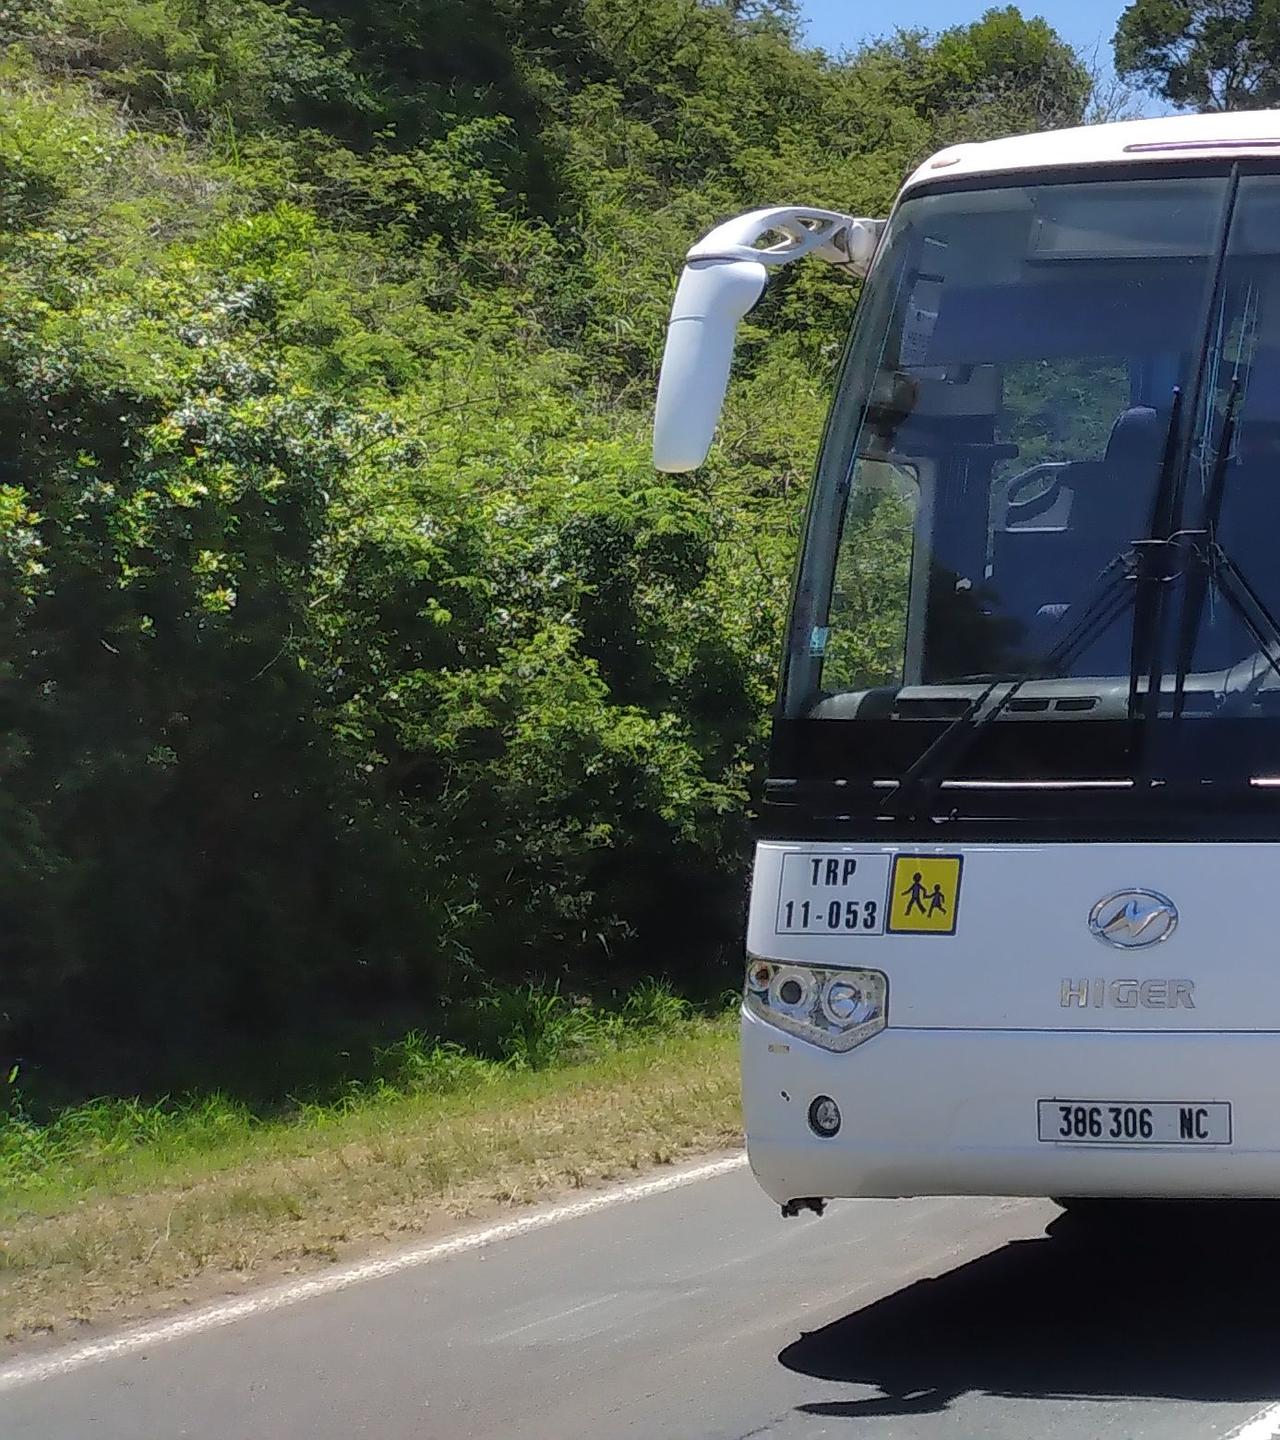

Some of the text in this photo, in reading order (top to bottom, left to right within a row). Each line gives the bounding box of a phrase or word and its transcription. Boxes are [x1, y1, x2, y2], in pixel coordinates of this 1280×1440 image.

[811, 858, 857, 886] TRP
[785, 900, 877, 929] 11-053
[1060, 977, 1196, 1009] HIGER
[1059, 1106, 1209, 1139] 386 306 NC
